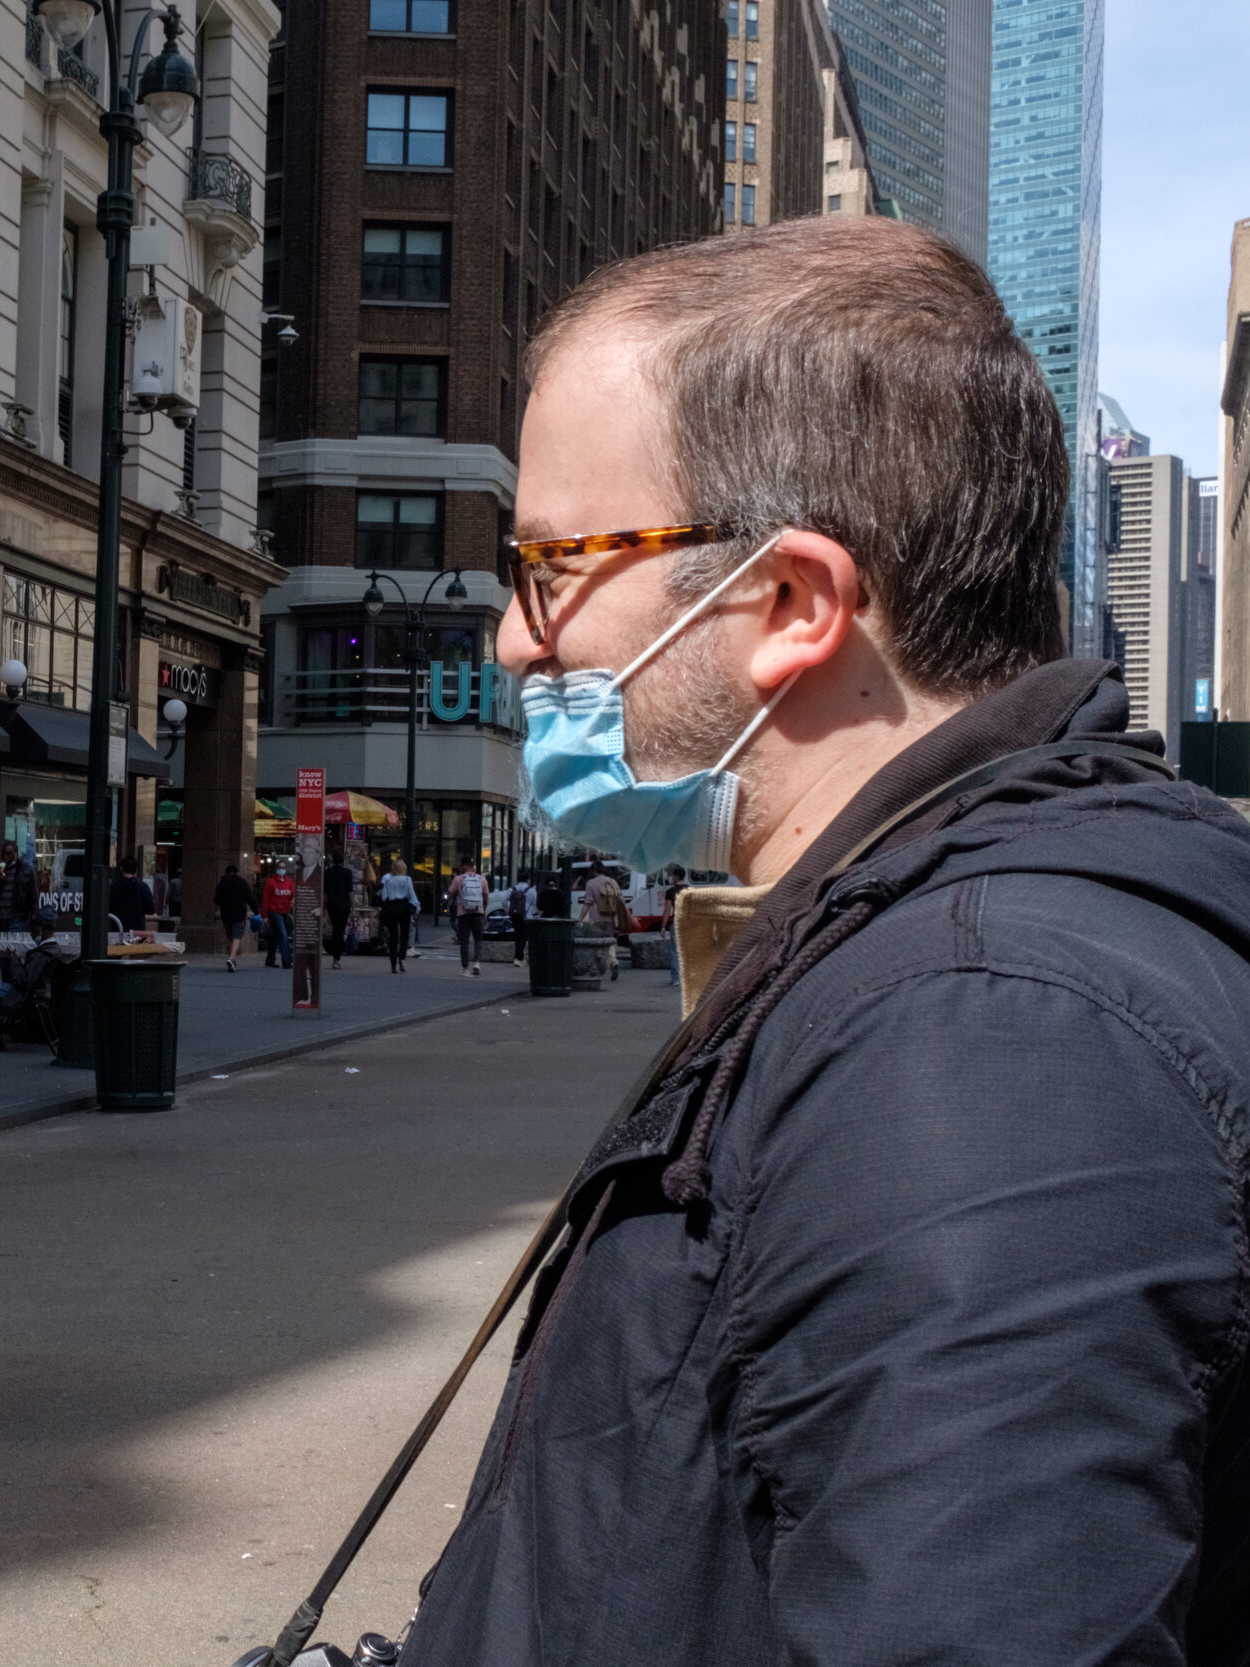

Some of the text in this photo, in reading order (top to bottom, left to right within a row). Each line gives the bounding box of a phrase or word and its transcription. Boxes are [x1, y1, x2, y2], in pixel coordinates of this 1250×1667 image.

[298, 770, 322, 778] know
[298, 778, 322, 787] NYC
[60, 891, 73, 912] OF
